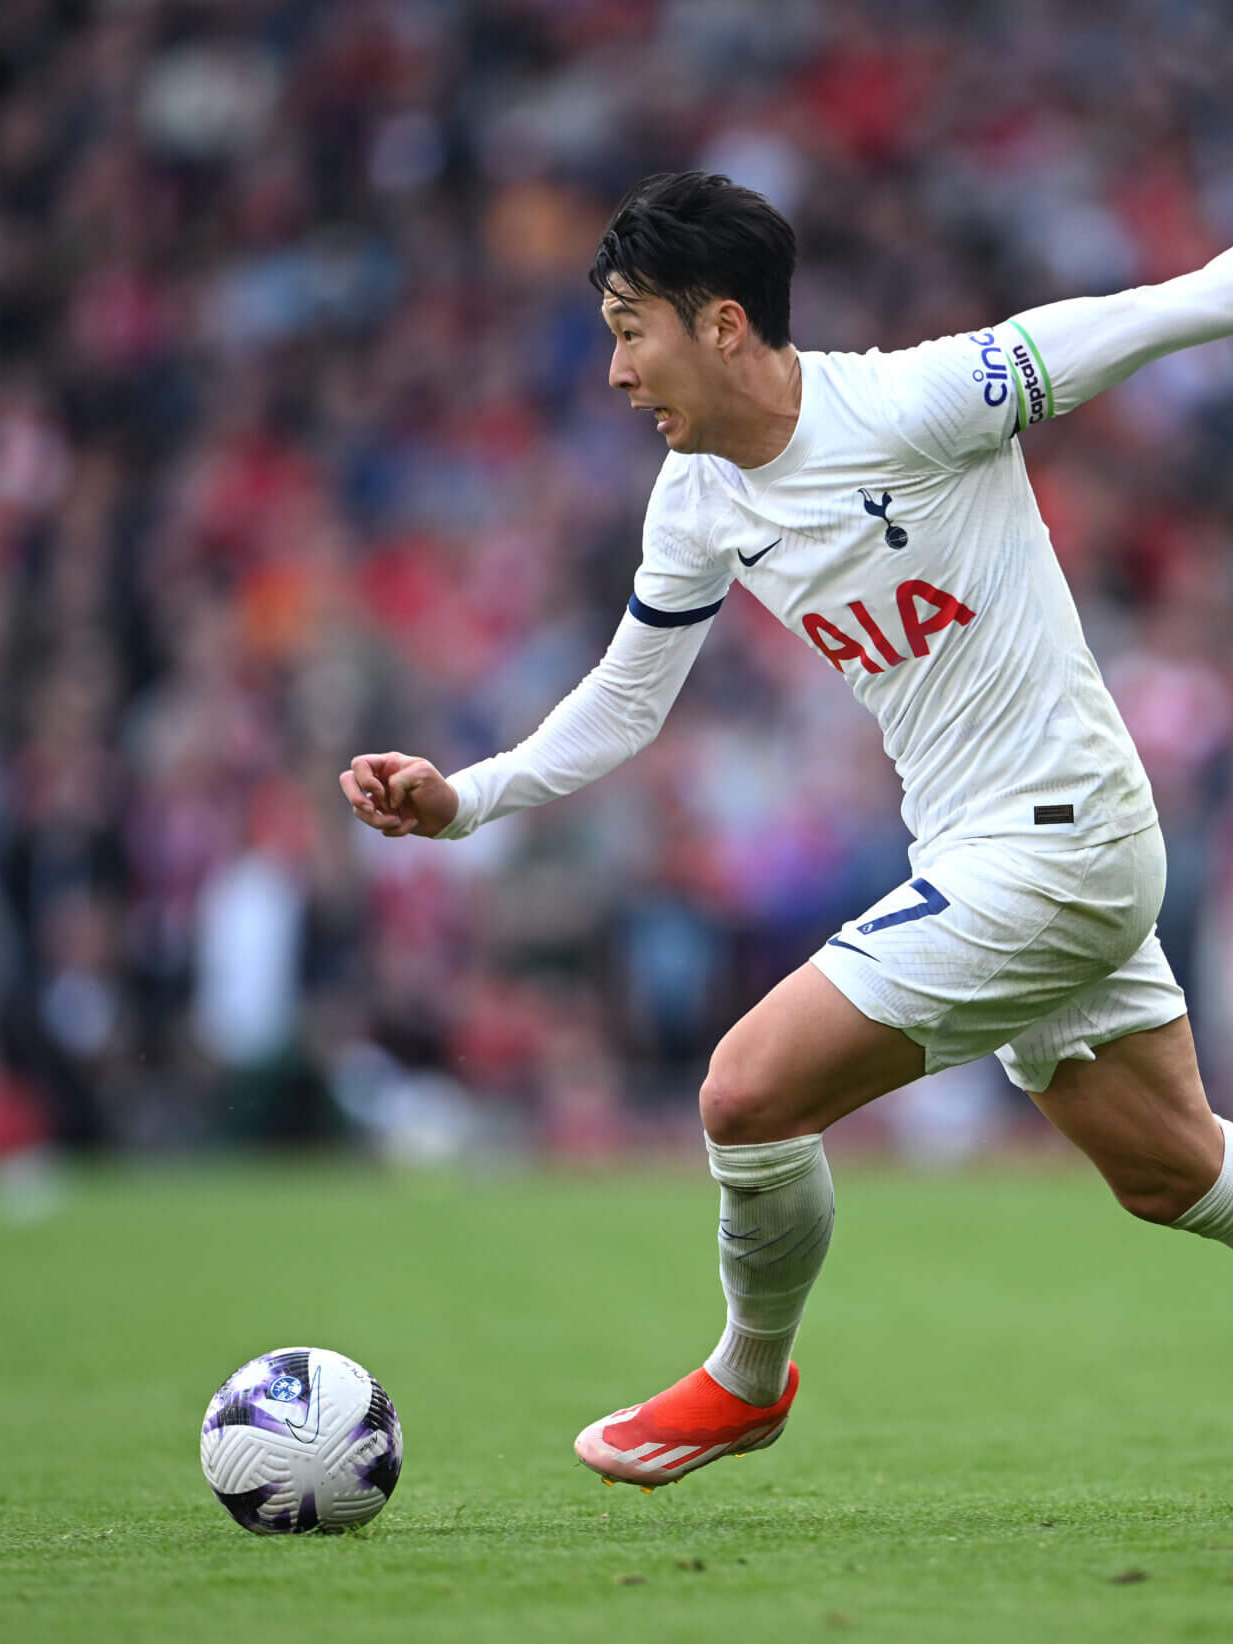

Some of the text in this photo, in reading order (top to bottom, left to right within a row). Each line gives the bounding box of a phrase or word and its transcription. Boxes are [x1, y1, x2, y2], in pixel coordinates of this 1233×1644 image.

[970, 329, 1008, 407] cinc
[1013, 345, 1046, 424] captain
[802, 579, 977, 674] AIA
[856, 877, 951, 935] 7
